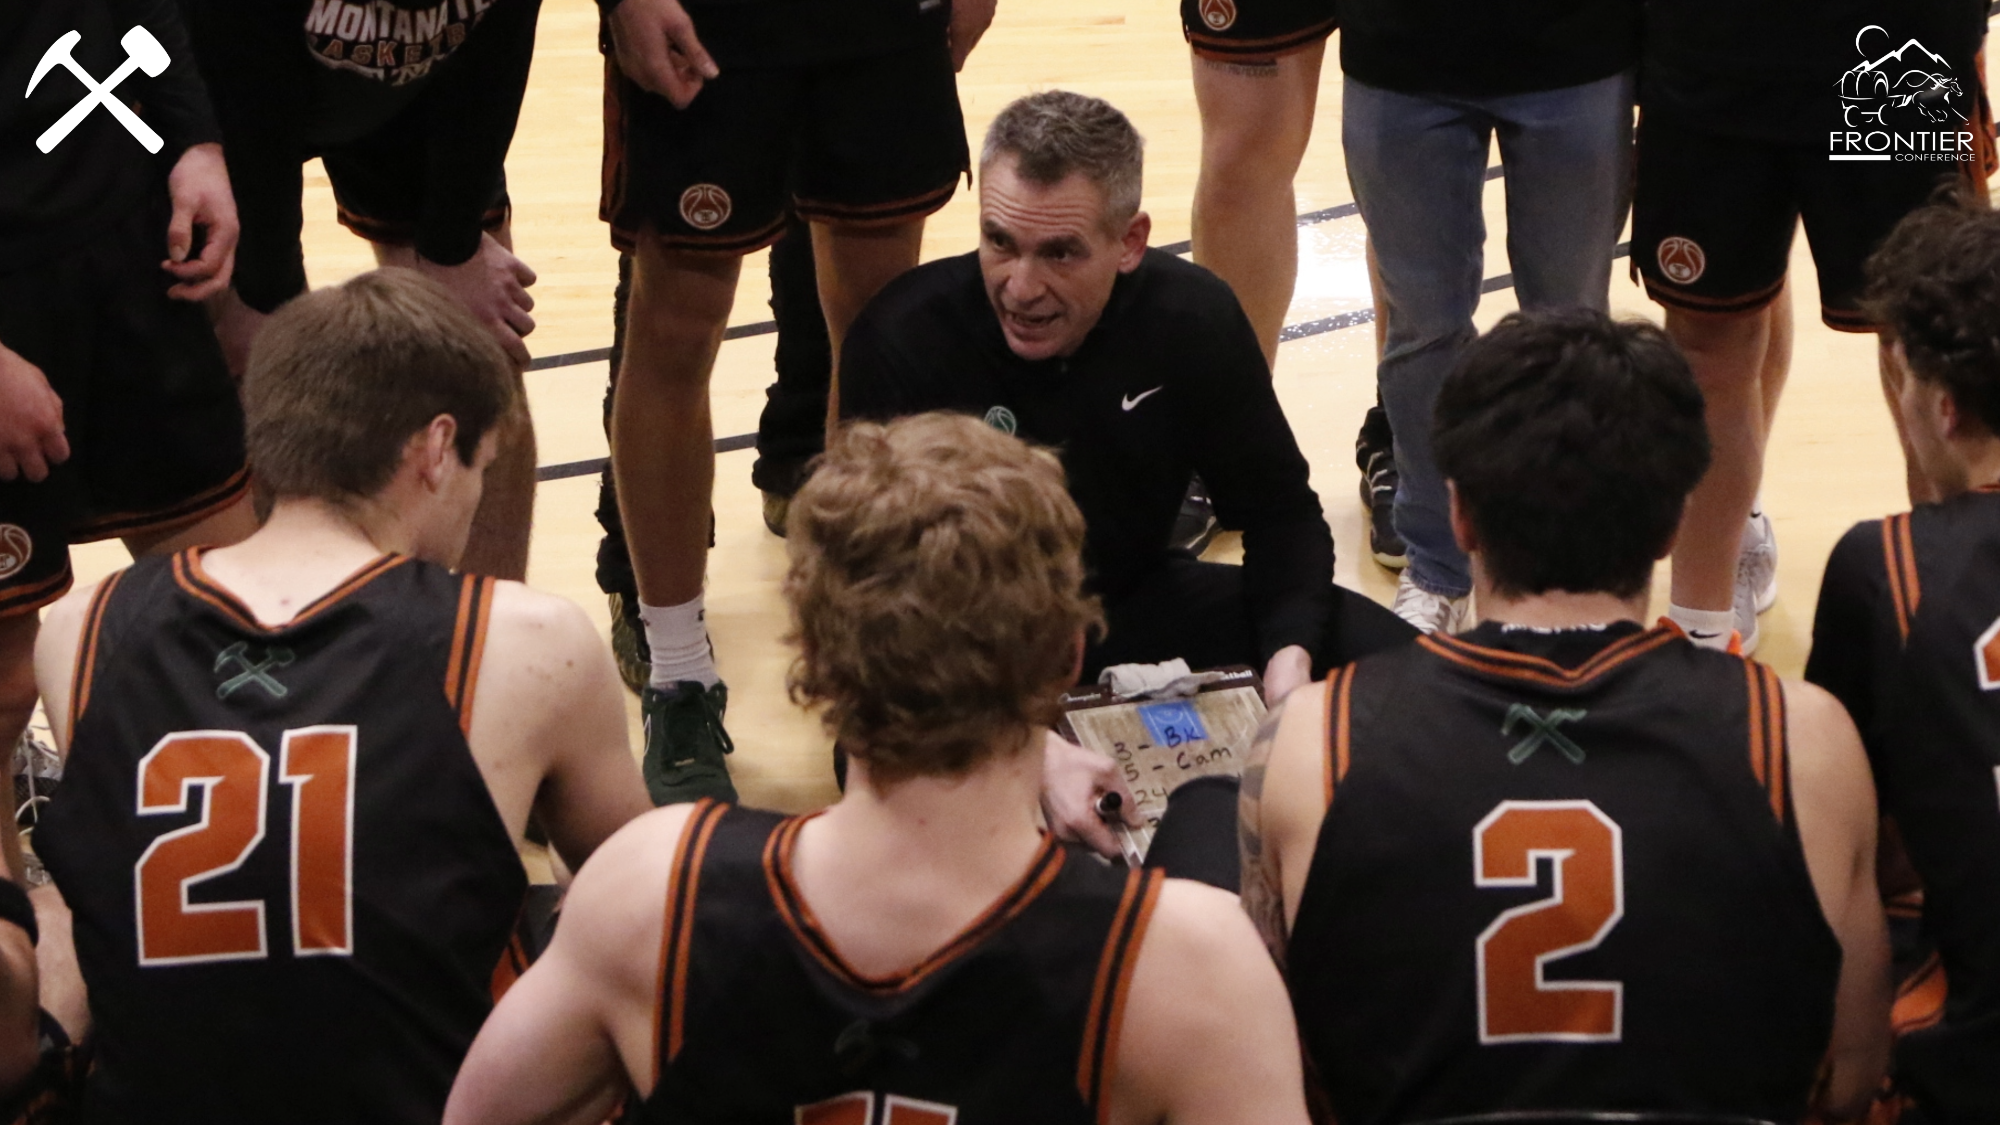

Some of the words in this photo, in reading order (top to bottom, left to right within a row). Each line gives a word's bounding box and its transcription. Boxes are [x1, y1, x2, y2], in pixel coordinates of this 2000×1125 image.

[136, 725, 358, 966] 21
[1124, 763, 1139, 782] 5
[1473, 800, 1624, 1045] 2
